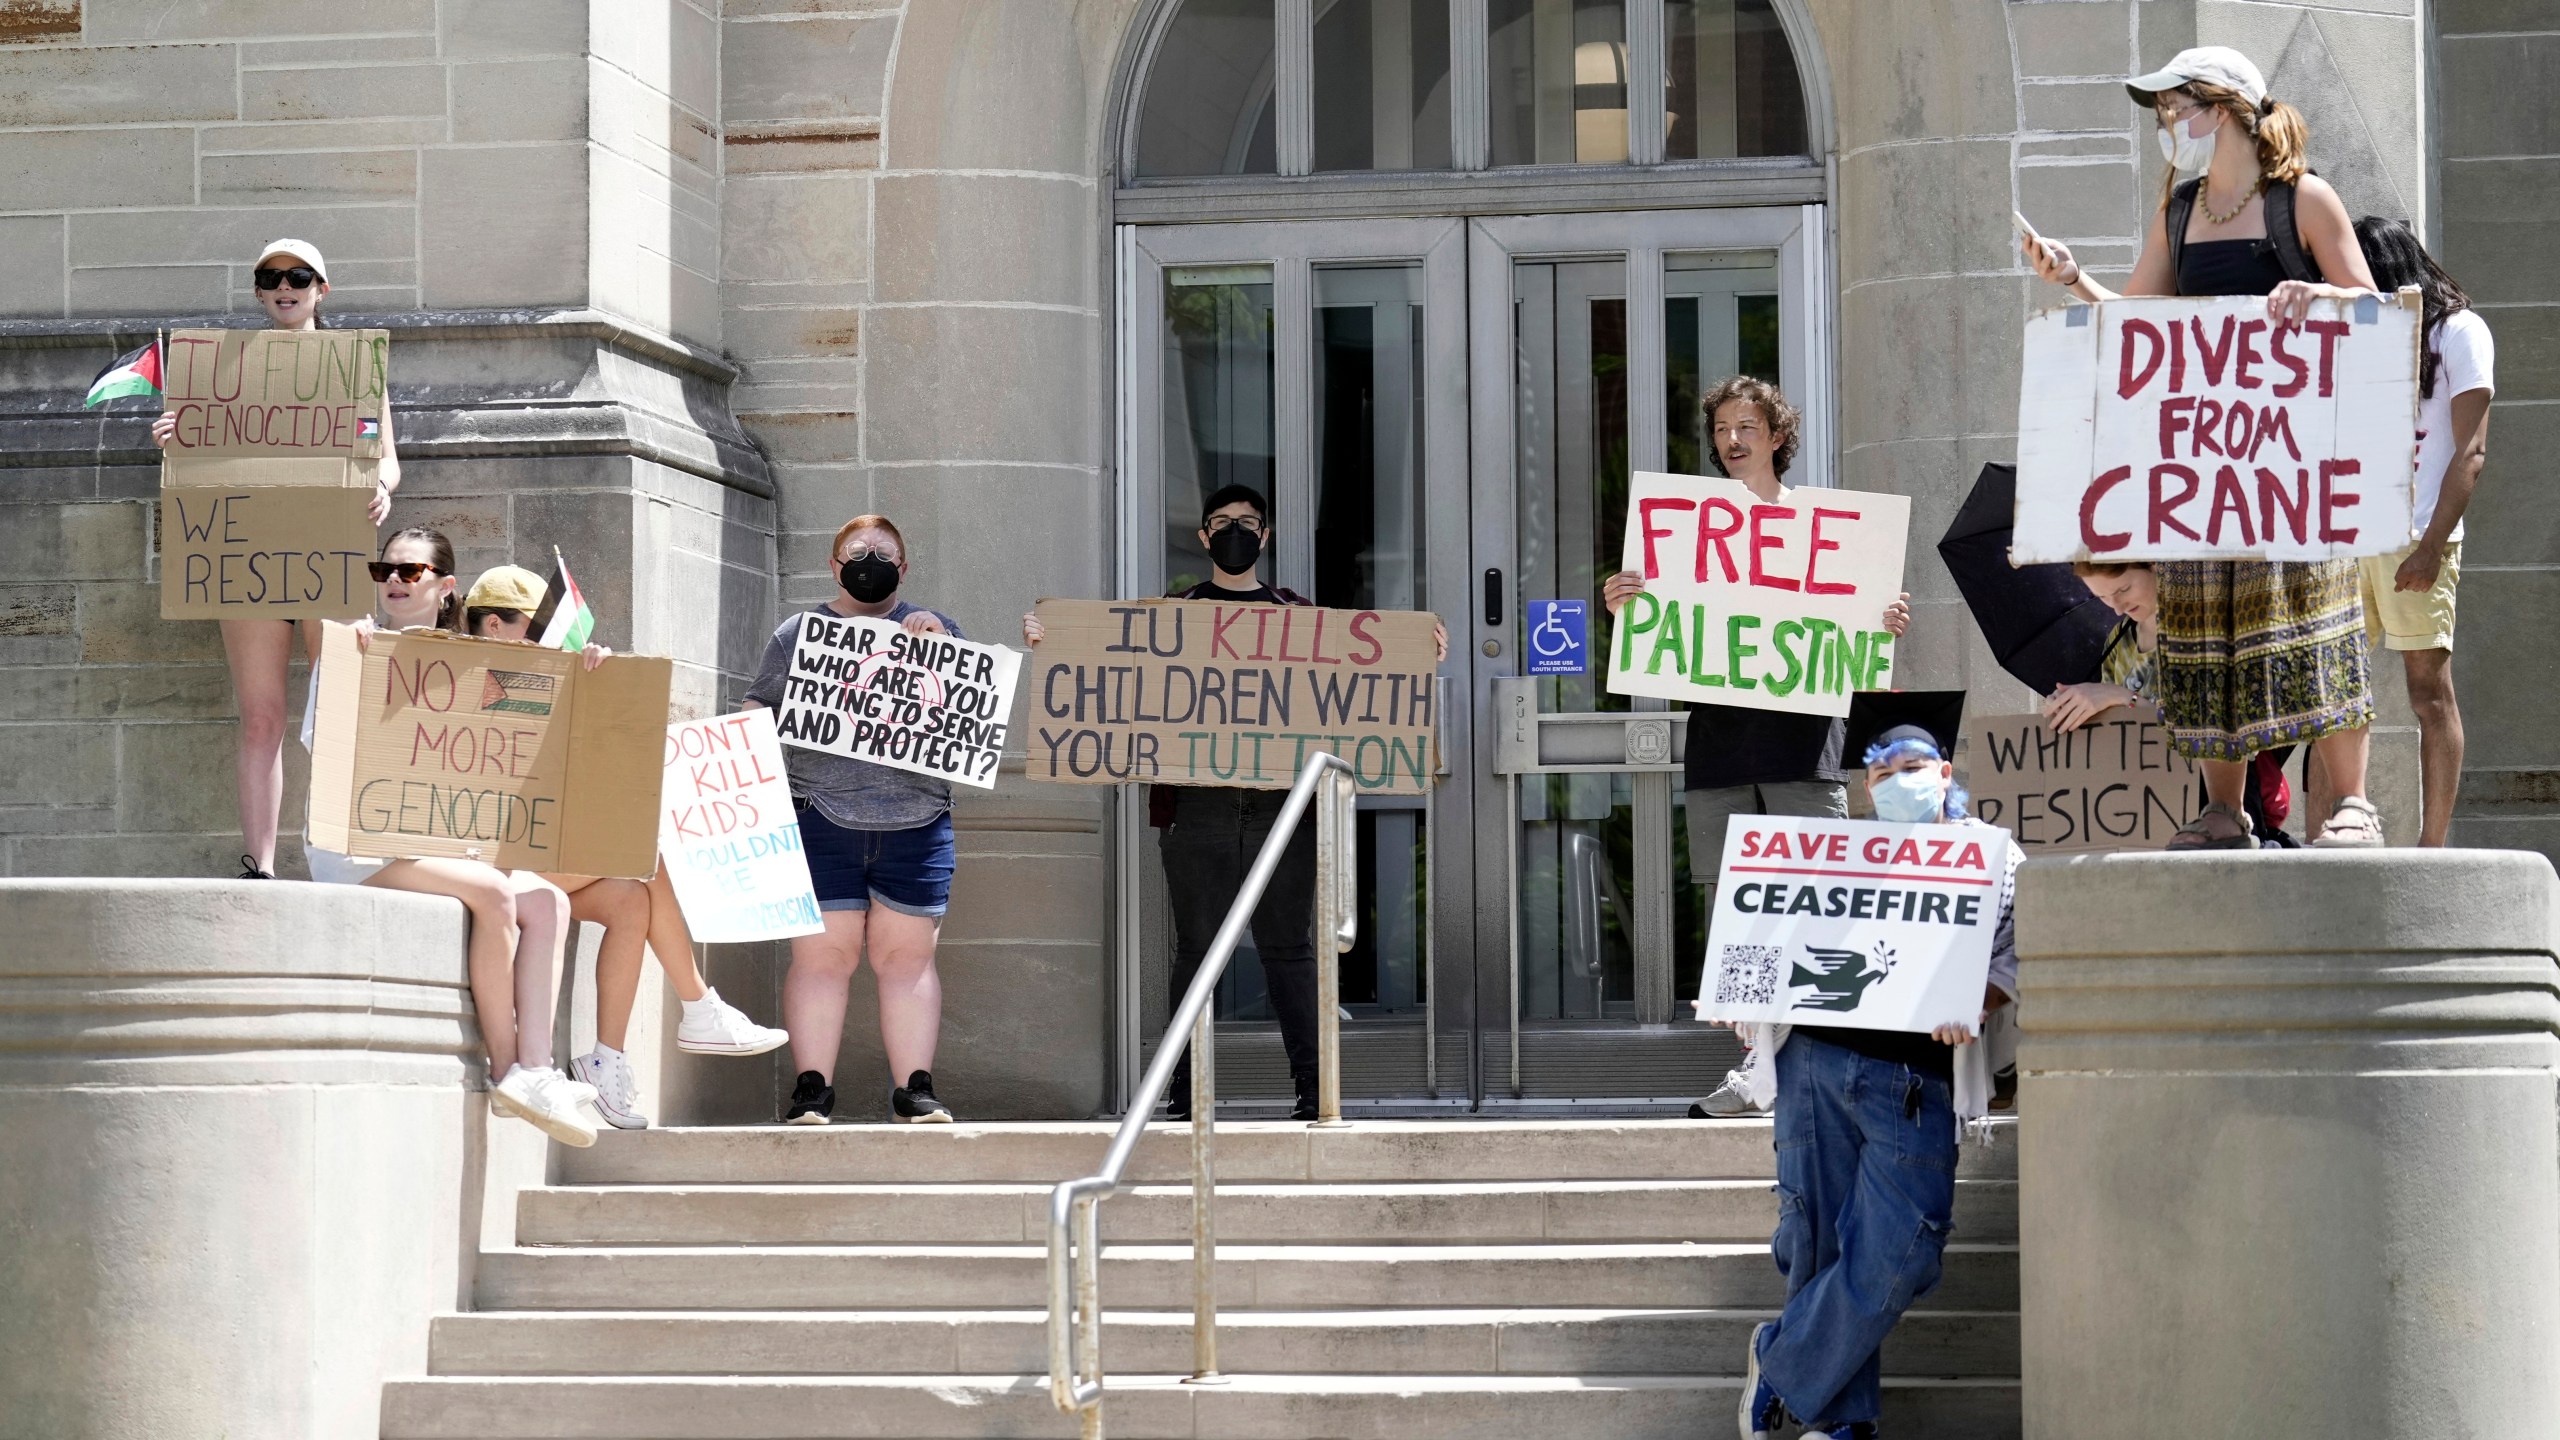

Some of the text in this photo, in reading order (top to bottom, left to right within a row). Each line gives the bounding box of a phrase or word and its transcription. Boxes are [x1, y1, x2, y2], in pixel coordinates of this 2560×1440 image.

[167, 336, 387, 402] IU FUNDS
[2117, 313, 2351, 400] DIVEST
[174, 403, 357, 448] GENOCIDE
[2158, 394, 2302, 464] FROM
[176, 495, 251, 543] WE
[2078, 457, 2361, 554] CRANE
[1639, 497, 1861, 595] FREE
[186, 551, 366, 604] RESIST
[805, 616, 876, 656] DEAR
[1105, 605, 1383, 666] IU KILLS
[1620, 591, 1895, 698] PALESTINE
[386, 655, 456, 712] NO
[786, 675, 1007, 750] TRYING TO SERVE
[798, 648, 999, 721] WHO ARE YOU
[1044, 663, 1432, 728] CHILDREN WITH
[777, 708, 999, 782] AND PROTECT?
[1516, 695, 1525, 743] PULL
[410, 722, 539, 780] MORE
[690, 754, 776, 797] KILL
[1038, 726, 1159, 779] YOUR
[357, 778, 555, 850] GENOCIDE
[671, 793, 759, 844] KIDS
[1977, 783, 2189, 844] RESIGN
[1740, 830, 1987, 871] SAVE GAZA
[1733, 882, 1981, 927] CEASEFIRE
